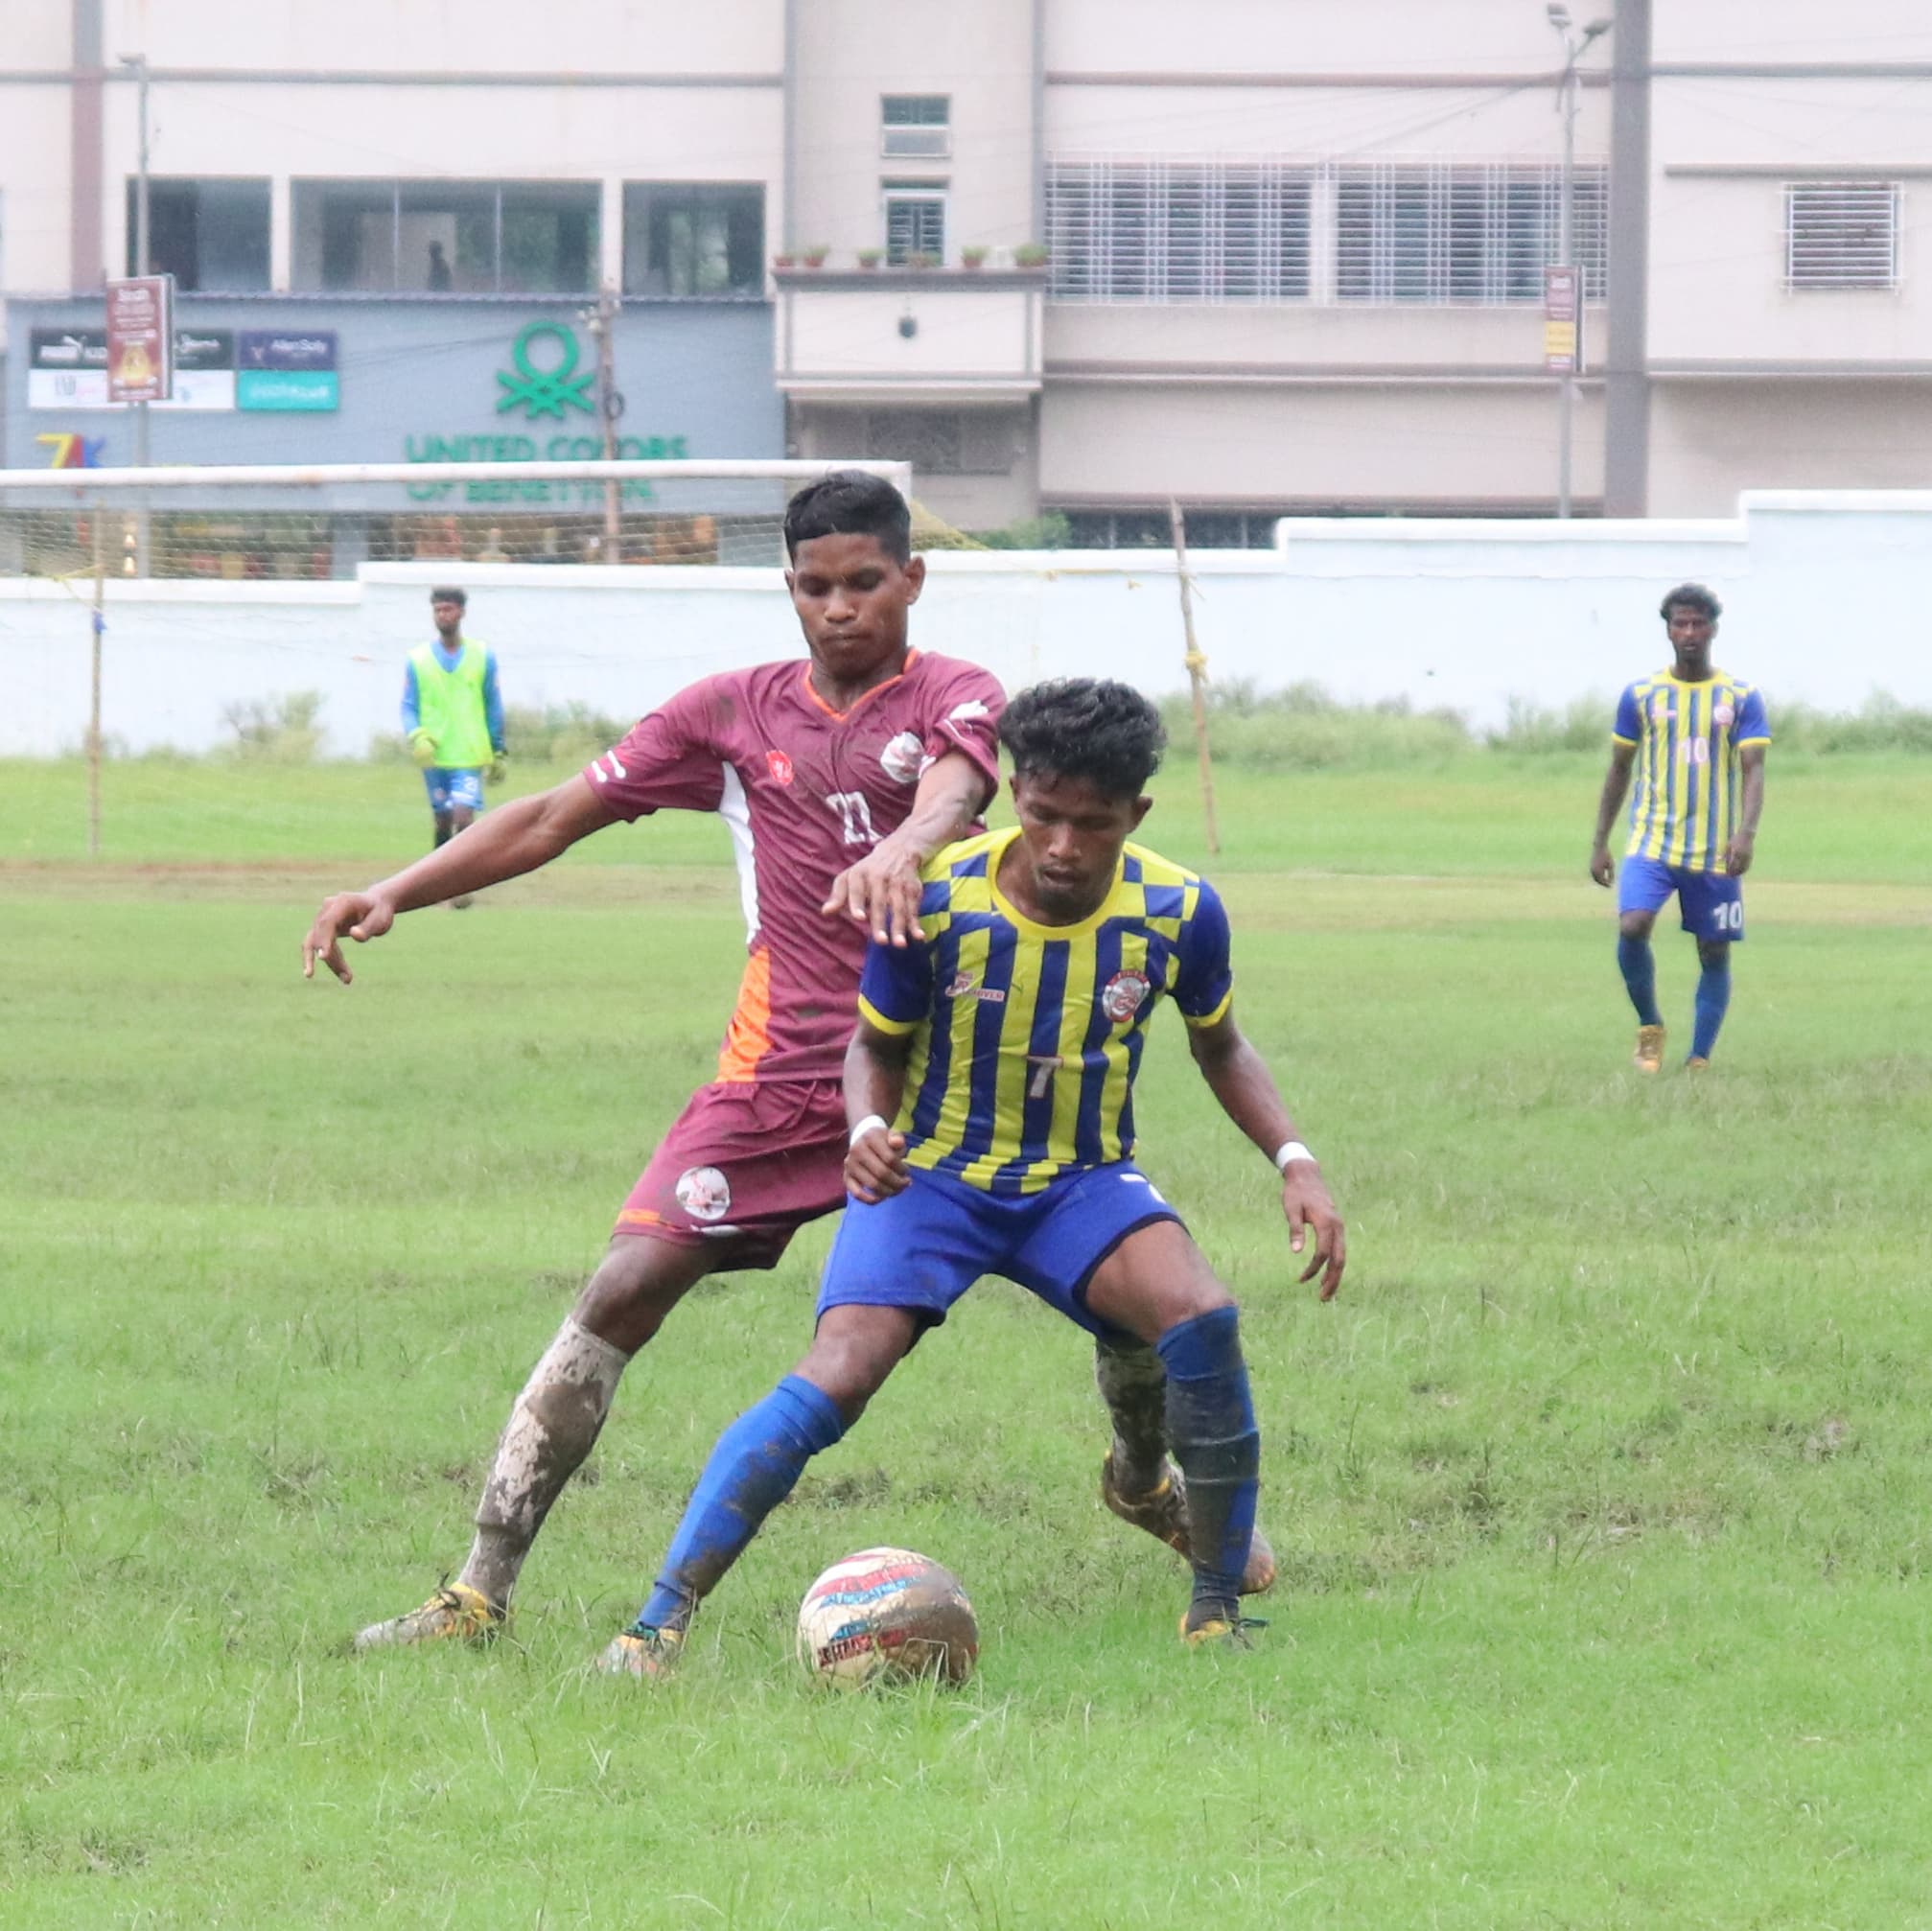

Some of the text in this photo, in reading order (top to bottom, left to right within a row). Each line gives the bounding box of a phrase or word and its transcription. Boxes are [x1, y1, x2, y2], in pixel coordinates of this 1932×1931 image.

[406, 434, 536, 462] UNITED
[1681, 736, 1709, 763] 10
[1713, 900, 1743, 929] 10
[1026, 1056, 1062, 1098] 7
